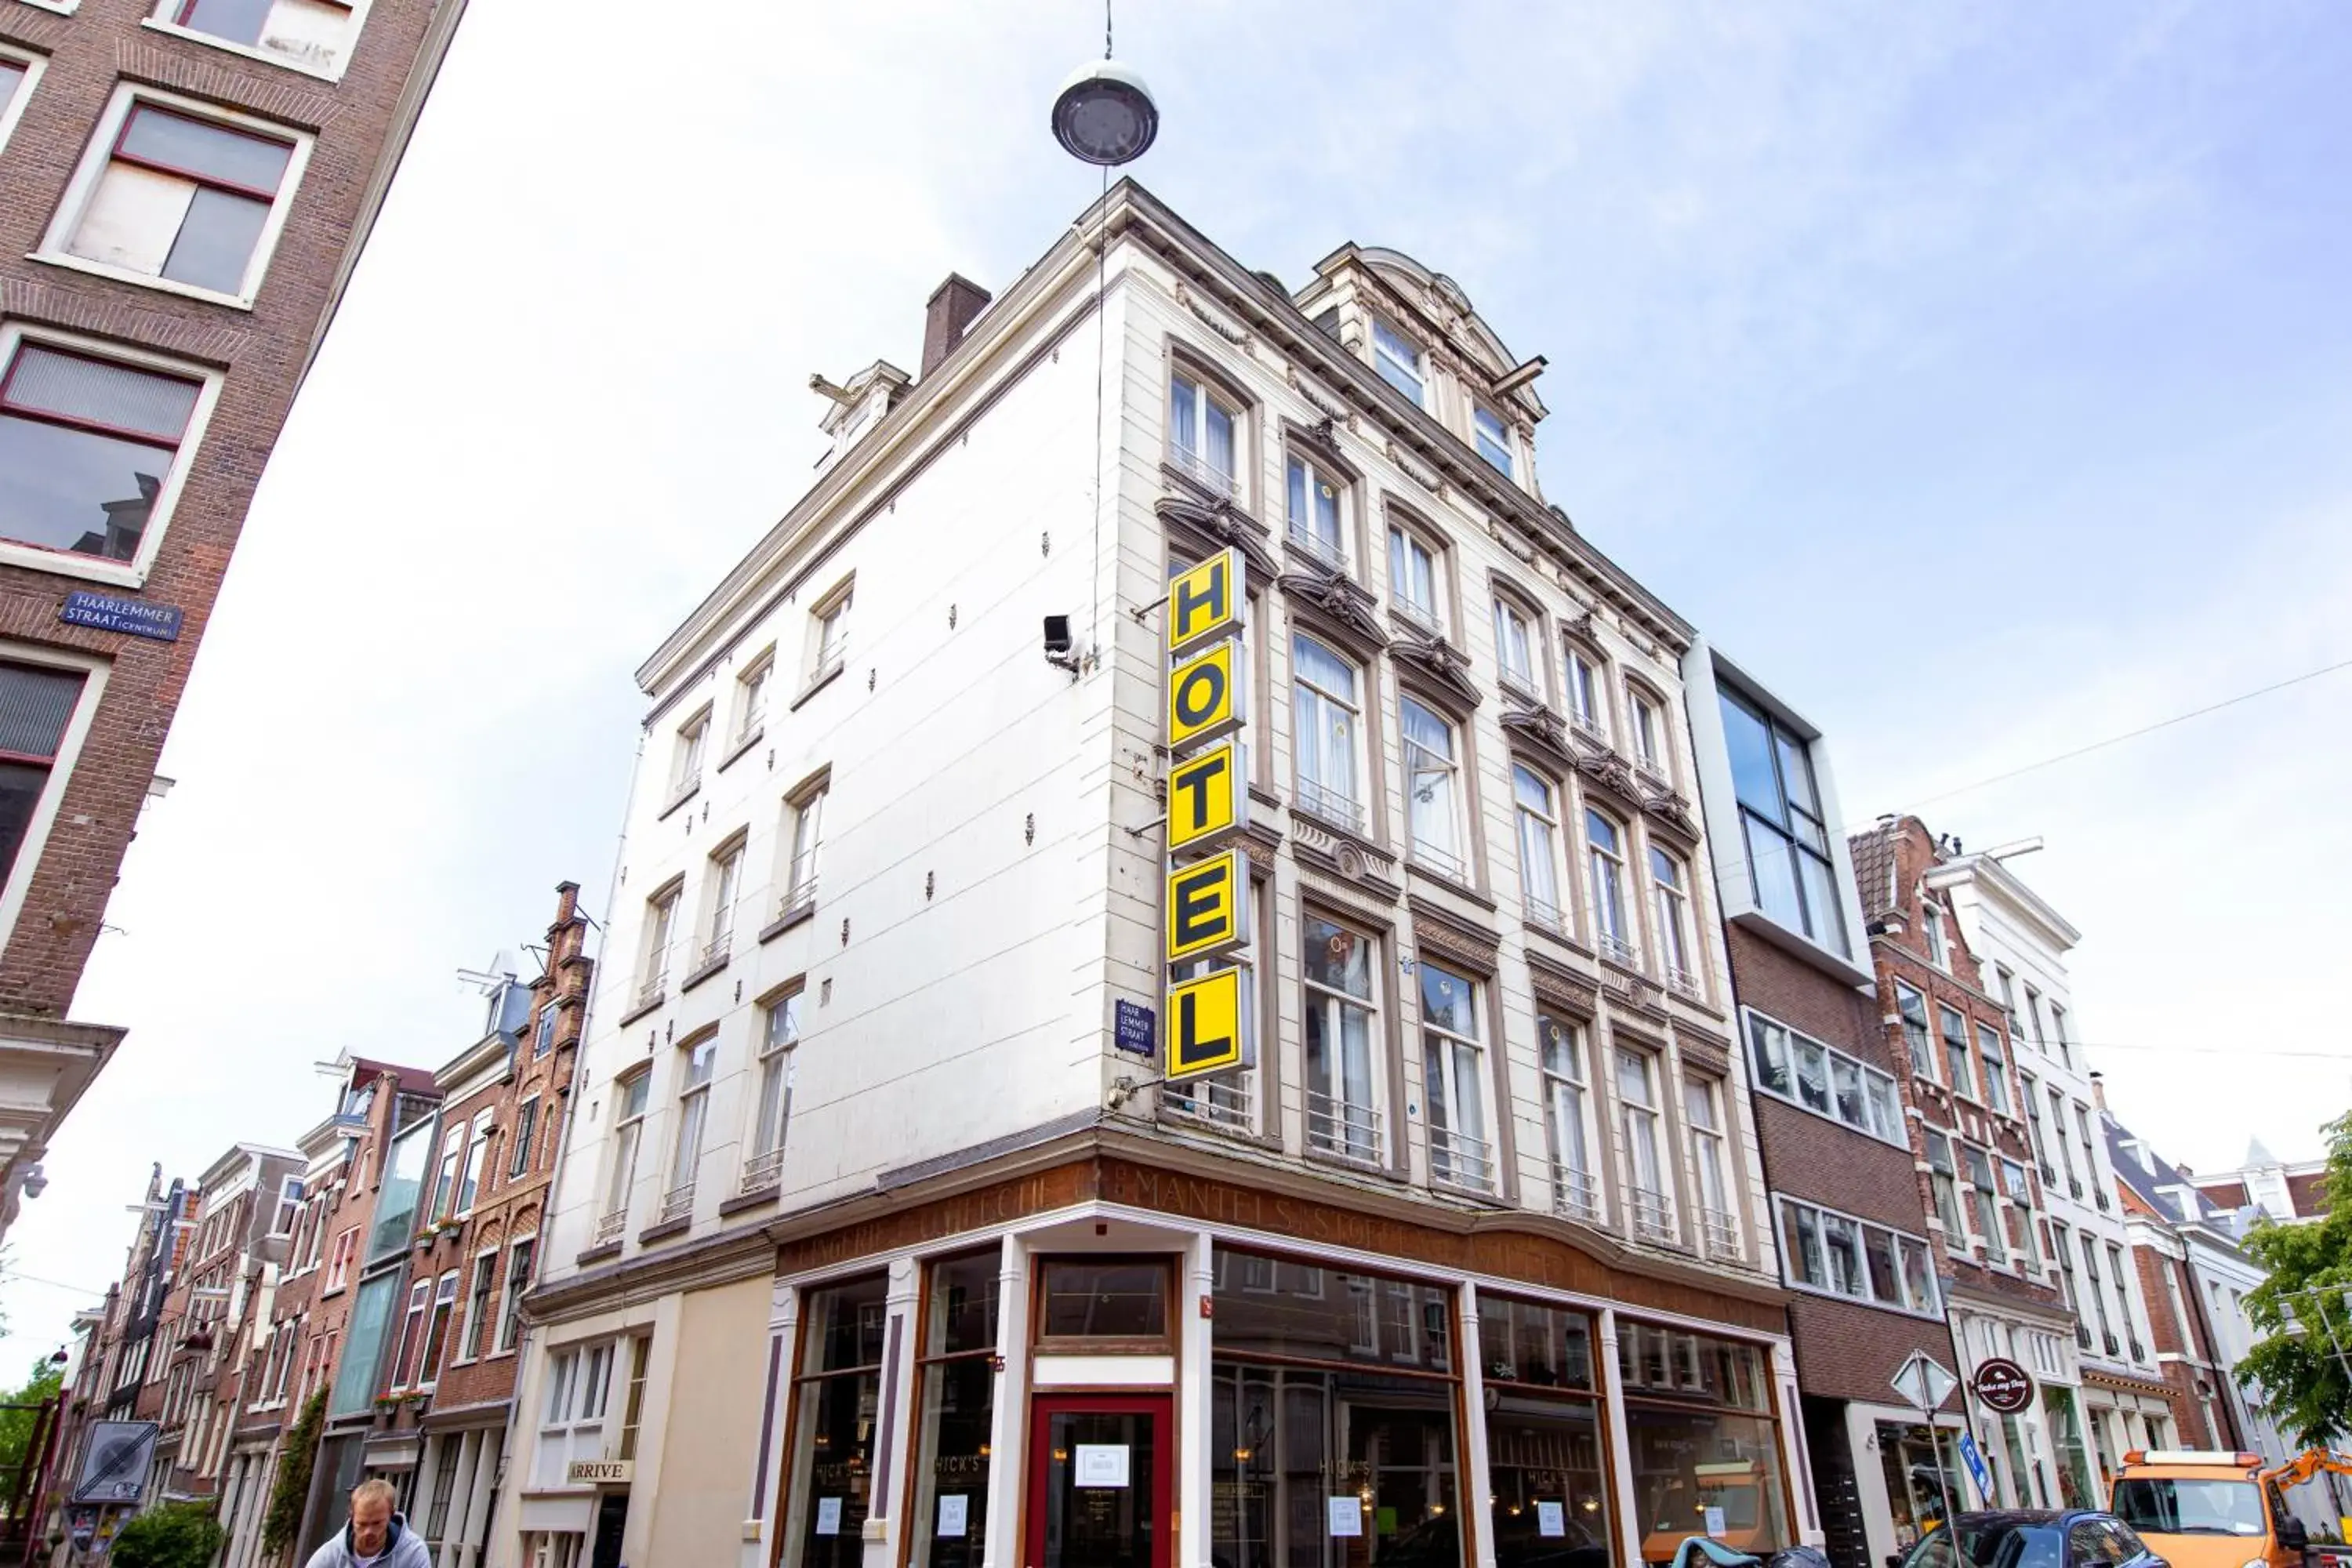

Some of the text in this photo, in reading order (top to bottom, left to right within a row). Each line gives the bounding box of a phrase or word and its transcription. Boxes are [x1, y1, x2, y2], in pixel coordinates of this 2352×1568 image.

[67, 608, 119, 626] STRAAT
[76, 595, 173, 623] HAARLEMMER
[1175, 562, 1232, 1065] HOTEL
[1120, 1015, 1149, 1031] LEMMER
